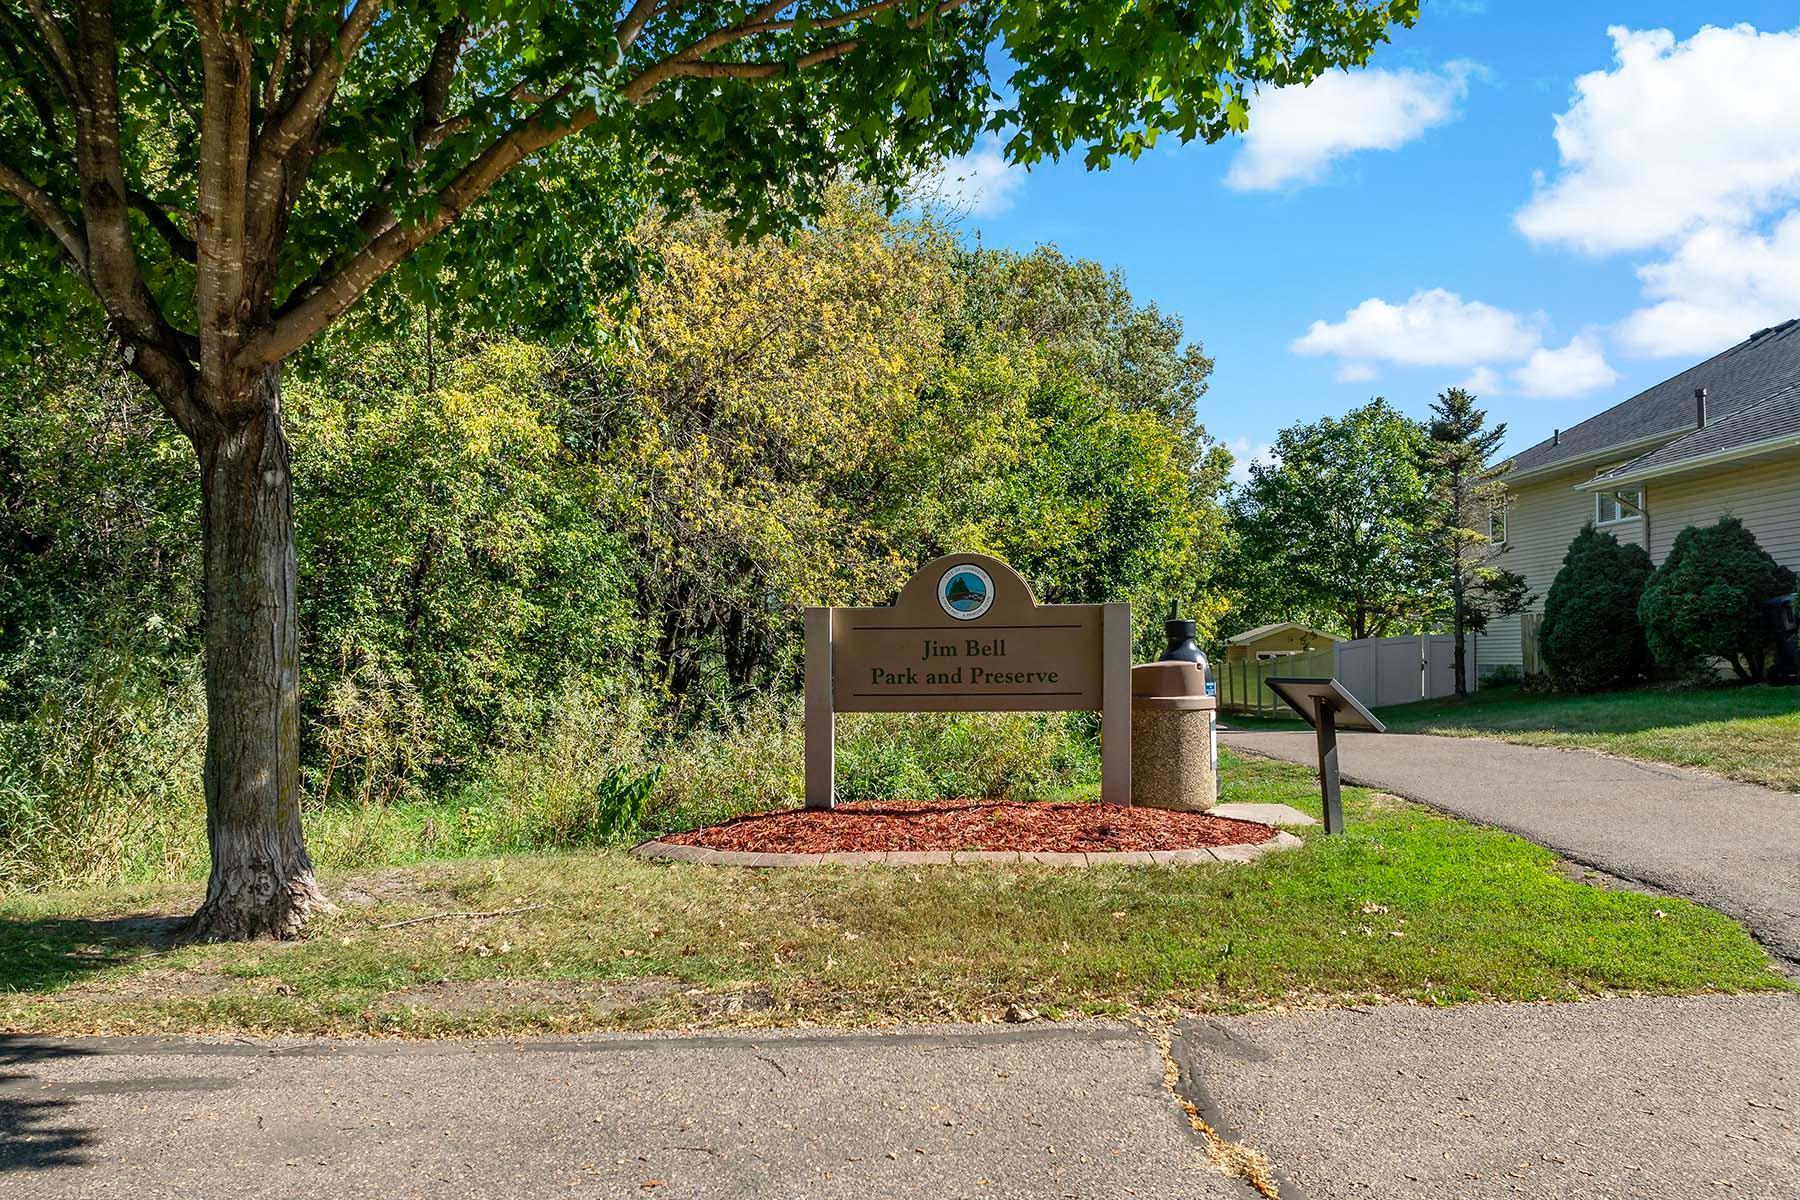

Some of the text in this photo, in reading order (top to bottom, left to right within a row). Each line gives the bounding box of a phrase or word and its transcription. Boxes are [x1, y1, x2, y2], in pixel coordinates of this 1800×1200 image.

[922, 639, 1007, 661] Jim Bell
[871, 667, 1059, 685] Park and Preserve
